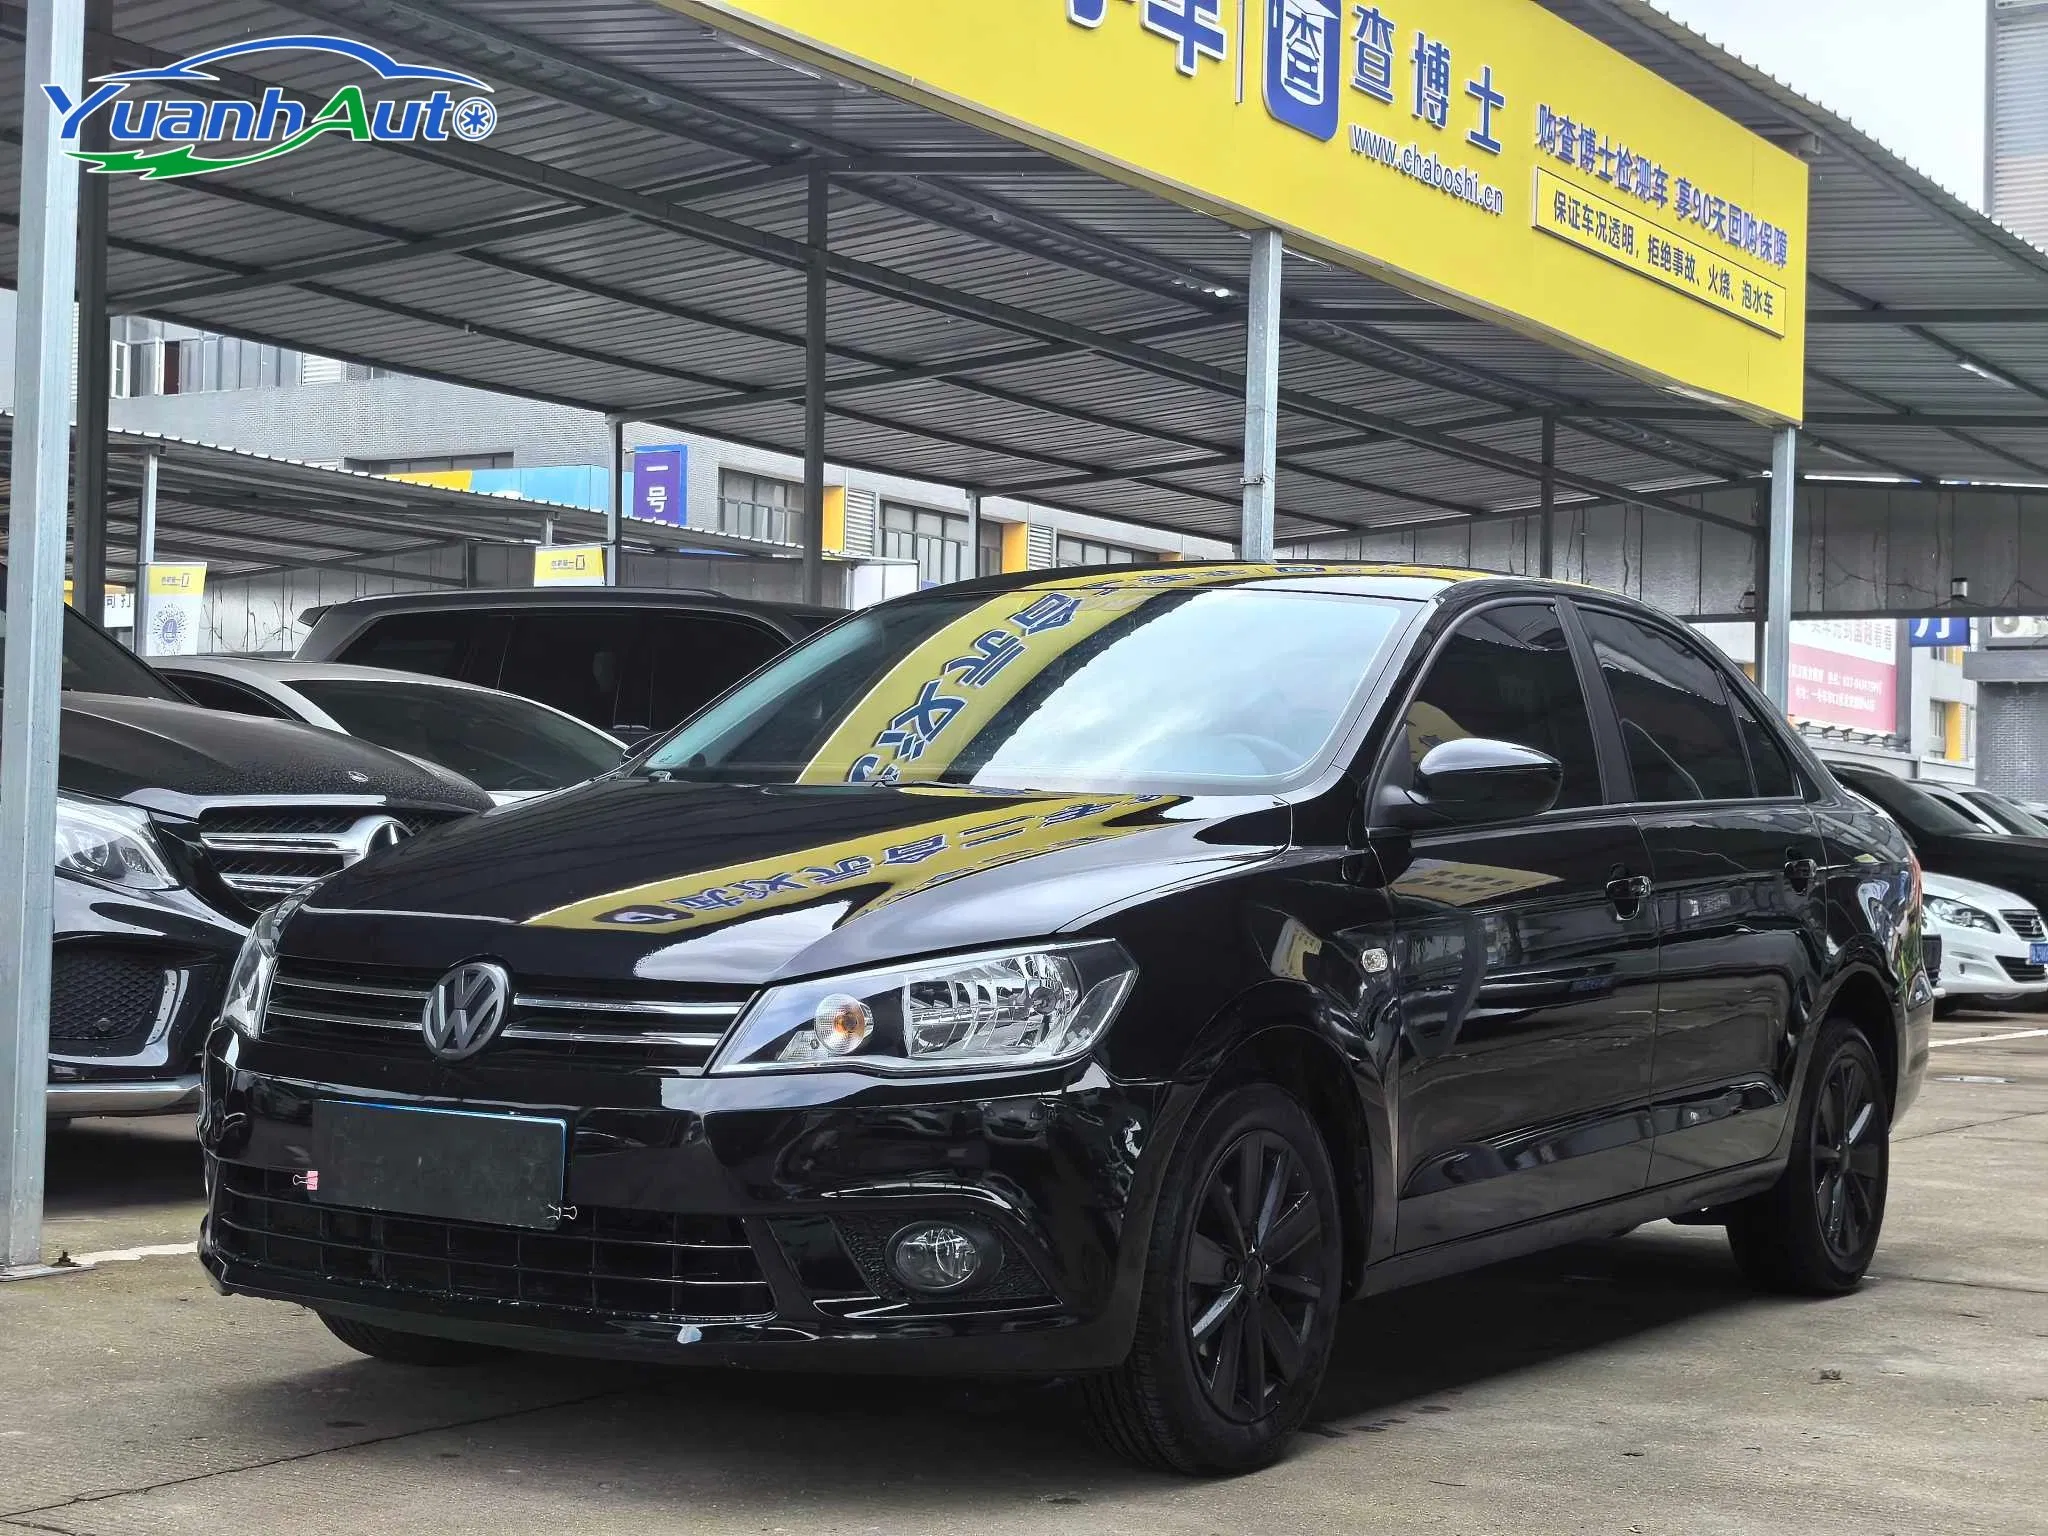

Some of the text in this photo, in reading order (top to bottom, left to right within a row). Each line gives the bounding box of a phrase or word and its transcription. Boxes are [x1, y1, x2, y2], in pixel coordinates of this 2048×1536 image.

[1350, 3, 1505, 154] 查博士
[1349, 122, 1505, 215] www.chaboshi.cn
[1535, 103, 1789, 270] 购查博士检测车 享90天回购保障
[646, 465, 669, 524] 一号
